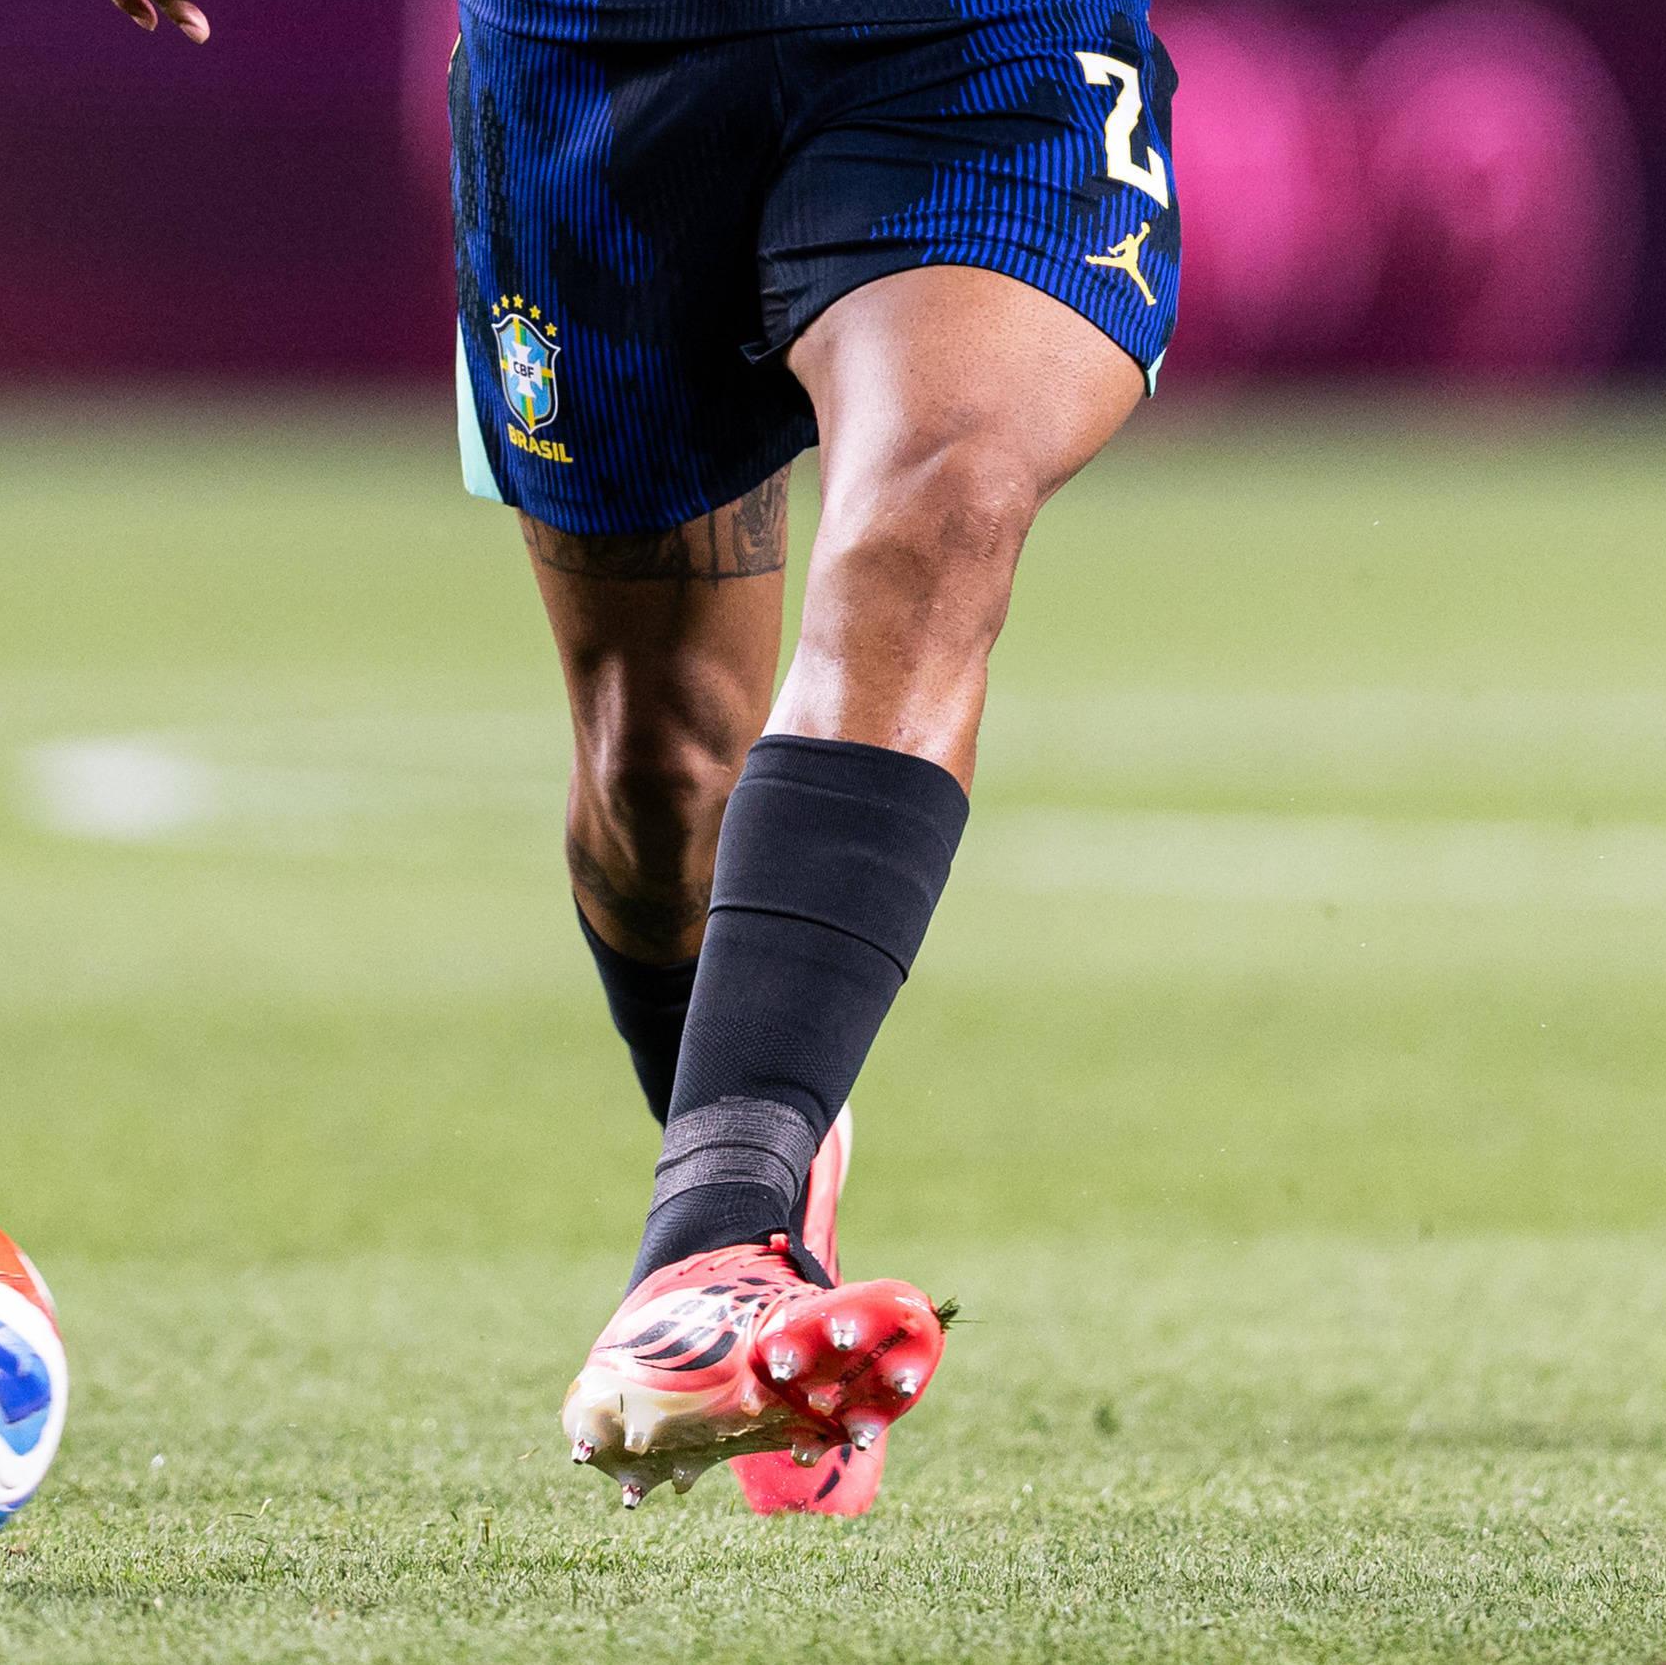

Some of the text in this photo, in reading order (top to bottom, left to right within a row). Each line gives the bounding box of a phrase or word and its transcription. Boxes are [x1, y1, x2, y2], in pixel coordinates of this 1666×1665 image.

[1074, 51, 1170, 210] 2
[513, 361, 534, 378] CBF
[507, 422, 574, 464] BRASIL
